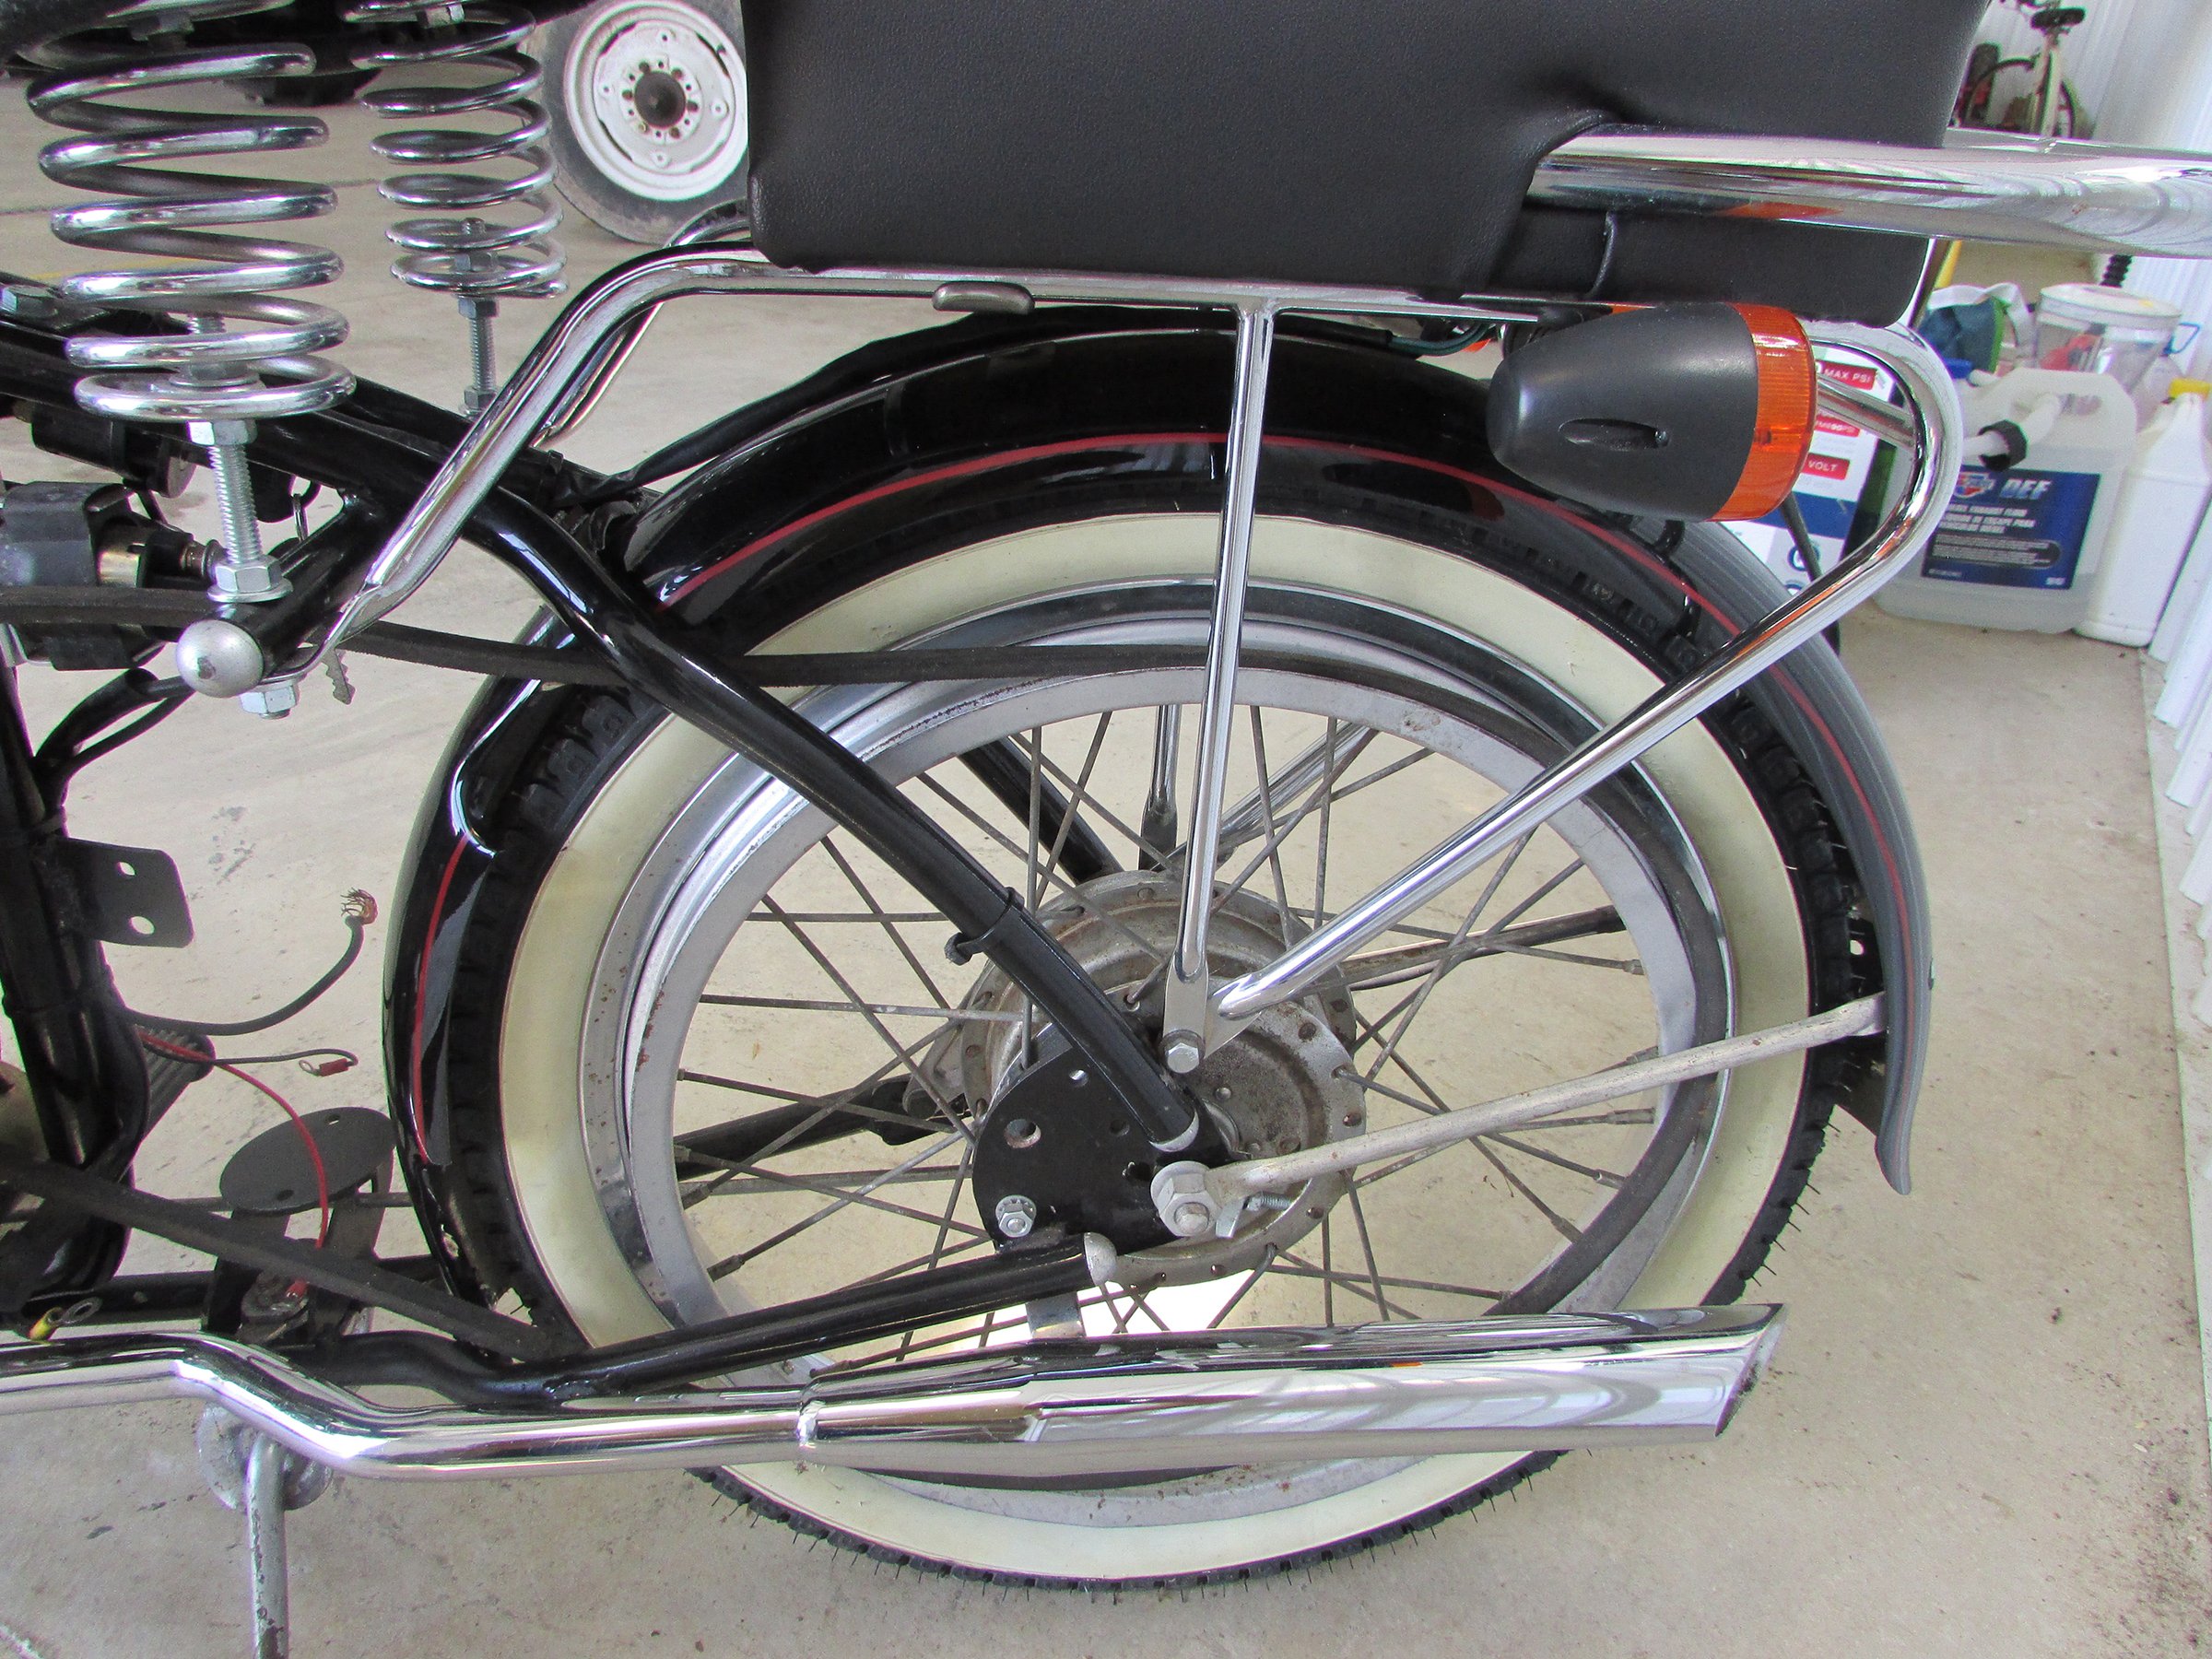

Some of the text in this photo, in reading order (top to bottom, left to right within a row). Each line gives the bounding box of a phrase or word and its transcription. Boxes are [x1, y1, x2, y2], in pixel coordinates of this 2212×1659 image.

[1824, 369, 1872, 383] MAX PSI
[1807, 460, 1838, 472] VOLT
